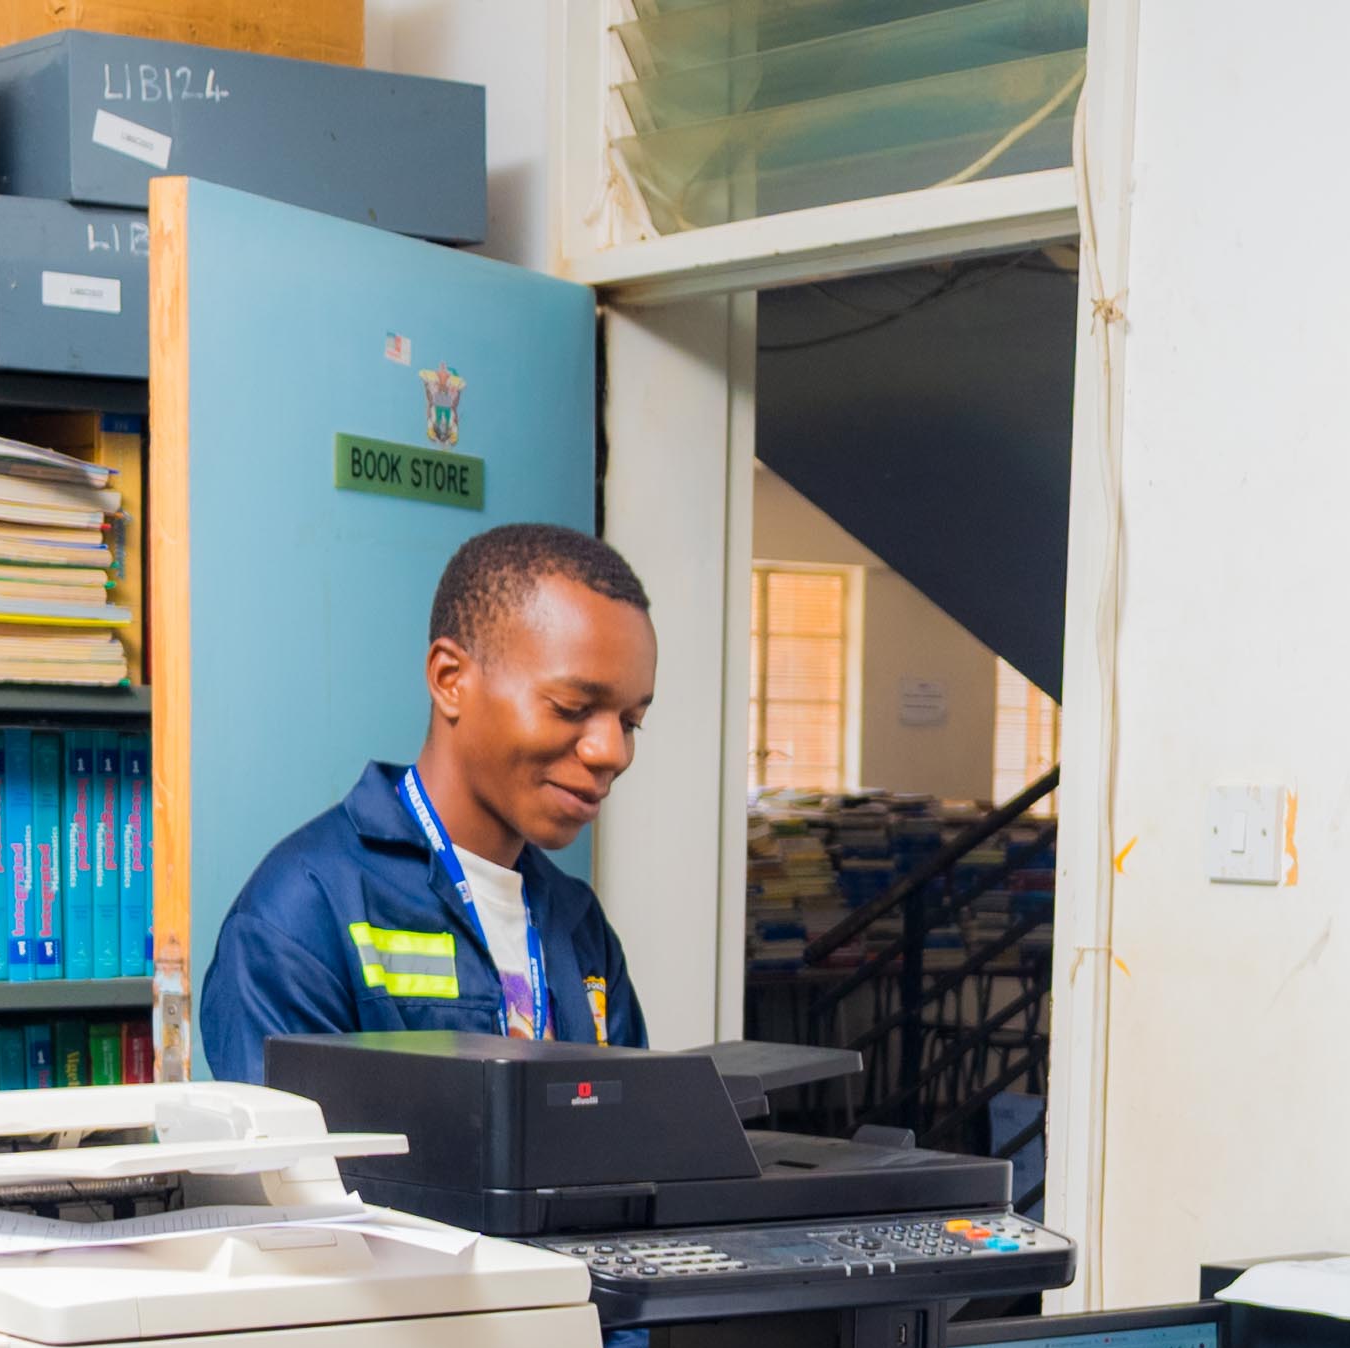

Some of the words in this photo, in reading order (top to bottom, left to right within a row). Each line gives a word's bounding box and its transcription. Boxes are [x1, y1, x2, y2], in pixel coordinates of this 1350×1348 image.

[104, 63, 230, 102] LIB124
[350, 447, 403, 485] BOOK
[410, 456, 470, 497] STORE
[77, 757, 85, 772] 1
[104, 757, 113, 772] 1
[131, 759, 140, 774] 1
[73, 778, 91, 871] Integrated
[101, 777, 118, 870] Integrated
[128, 780, 146, 872] Integrated
[11, 843, 29, 937] Integrated
[37, 844, 56, 937] Integrated
[17, 941, 27, 956] 1
[45, 941, 54, 957] 1
[37, 1051, 46, 1064] 1
[570, 1095, 600, 1106] olivetti
